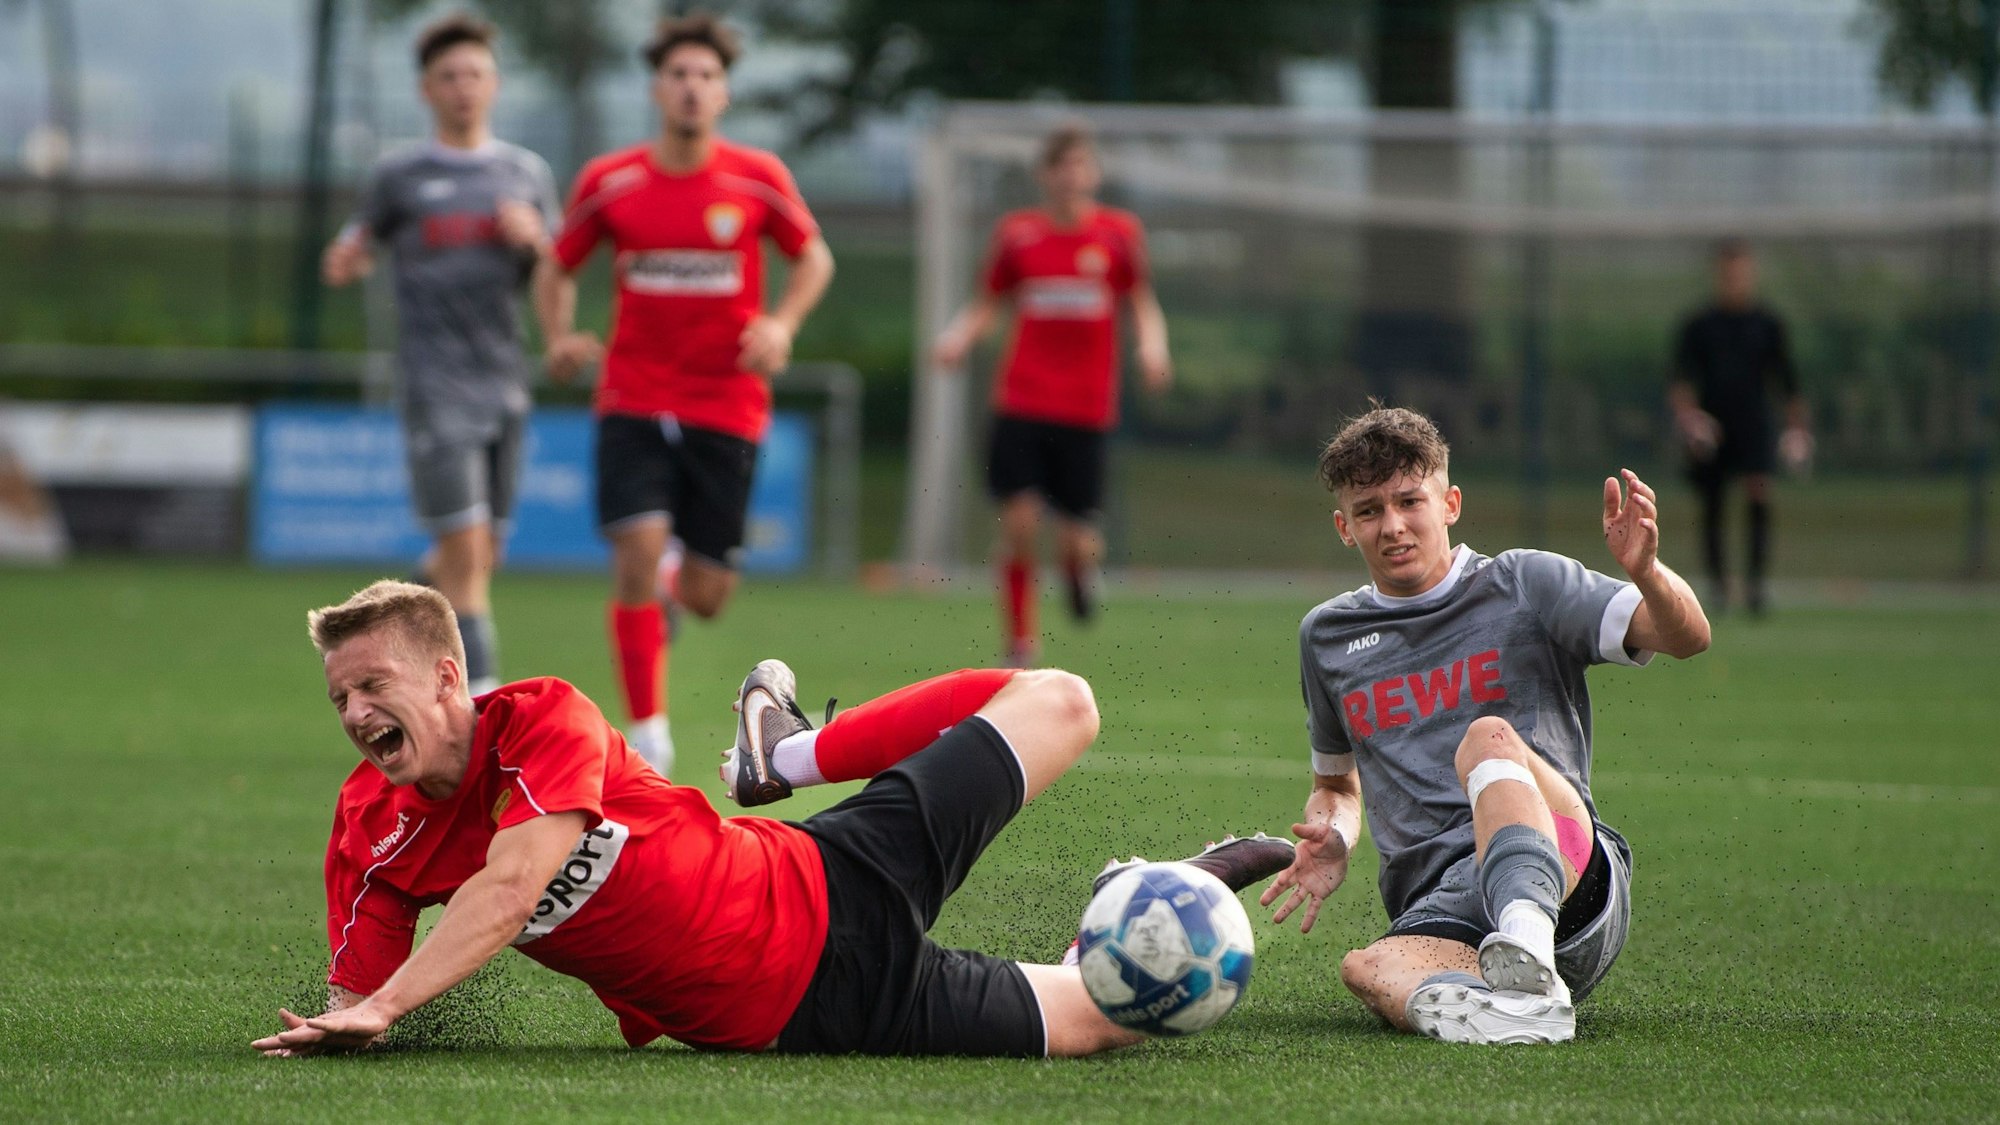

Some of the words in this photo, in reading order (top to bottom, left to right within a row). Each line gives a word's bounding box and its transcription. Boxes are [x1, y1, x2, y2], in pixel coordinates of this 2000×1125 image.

[1347, 632, 1380, 655] JAKO
[1342, 649, 1507, 743] REWE
[522, 827, 614, 932] sport
